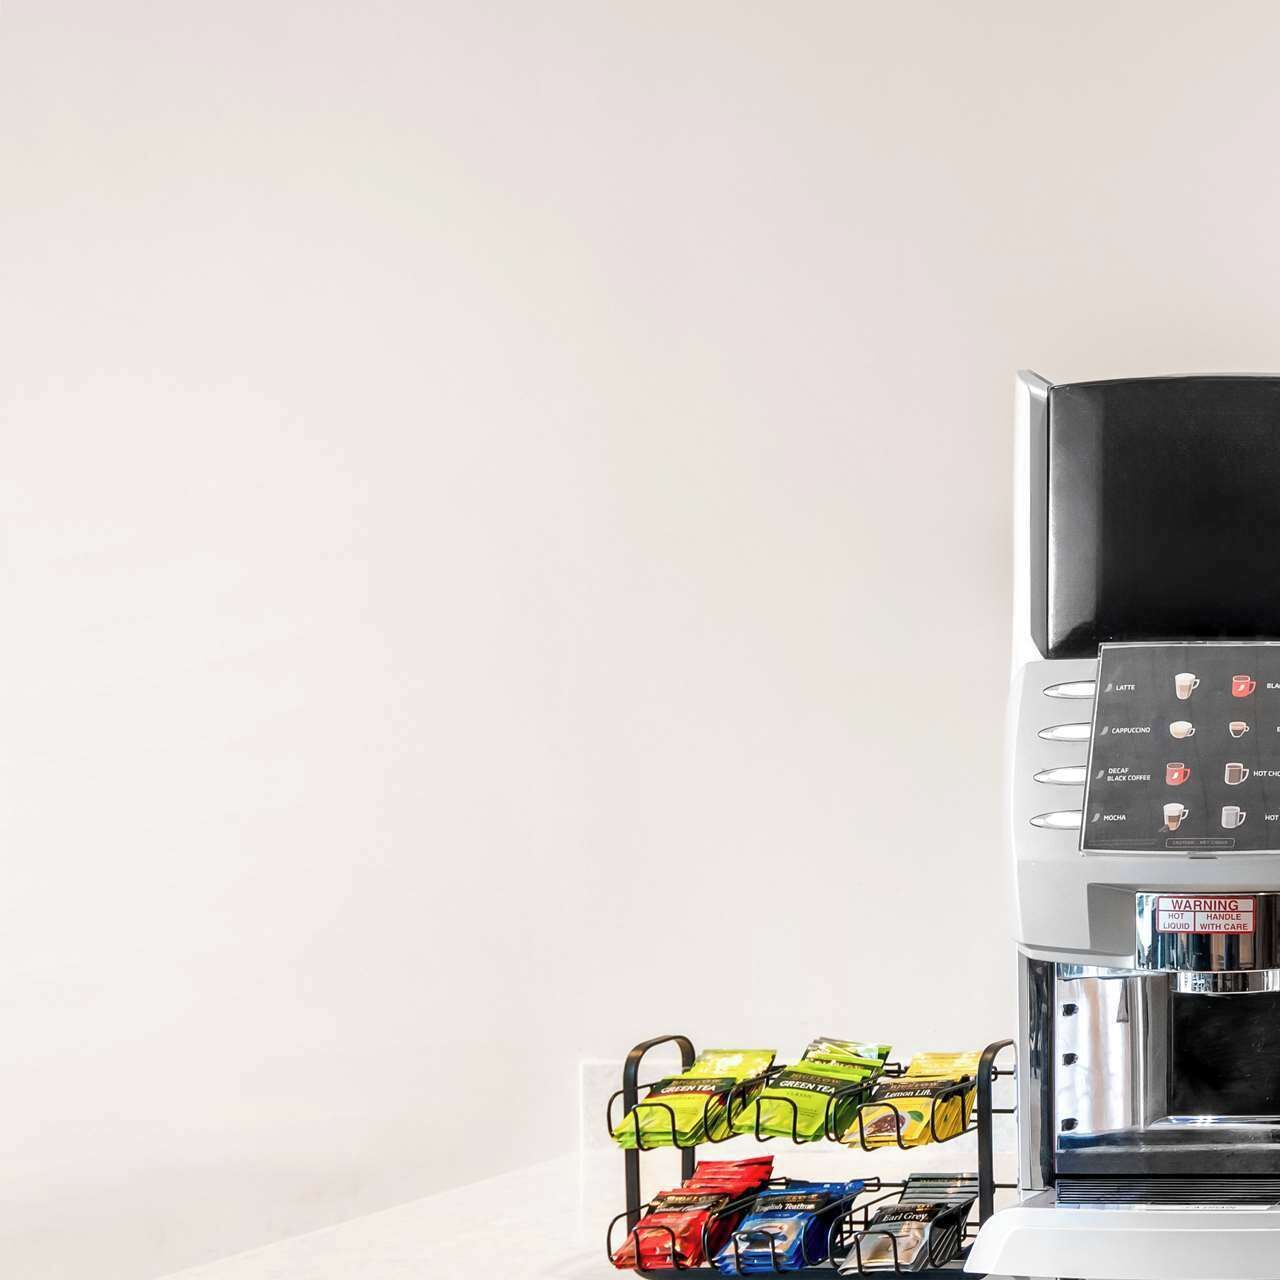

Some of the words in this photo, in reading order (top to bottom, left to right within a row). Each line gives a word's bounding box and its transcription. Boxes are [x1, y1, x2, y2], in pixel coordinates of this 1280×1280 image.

[1111, 726, 1151, 734] CAPPUCCINO
[1171, 900, 1239, 911] WARNING
[1163, 922, 1190, 930] LIQUID
[660, 1086, 696, 1094] GREEN
[780, 1080, 815, 1091] GREEN
[816, 1085, 836, 1094] TEA
[883, 1213, 903, 1221] Earl
[903, 1211, 929, 1222] Grey
